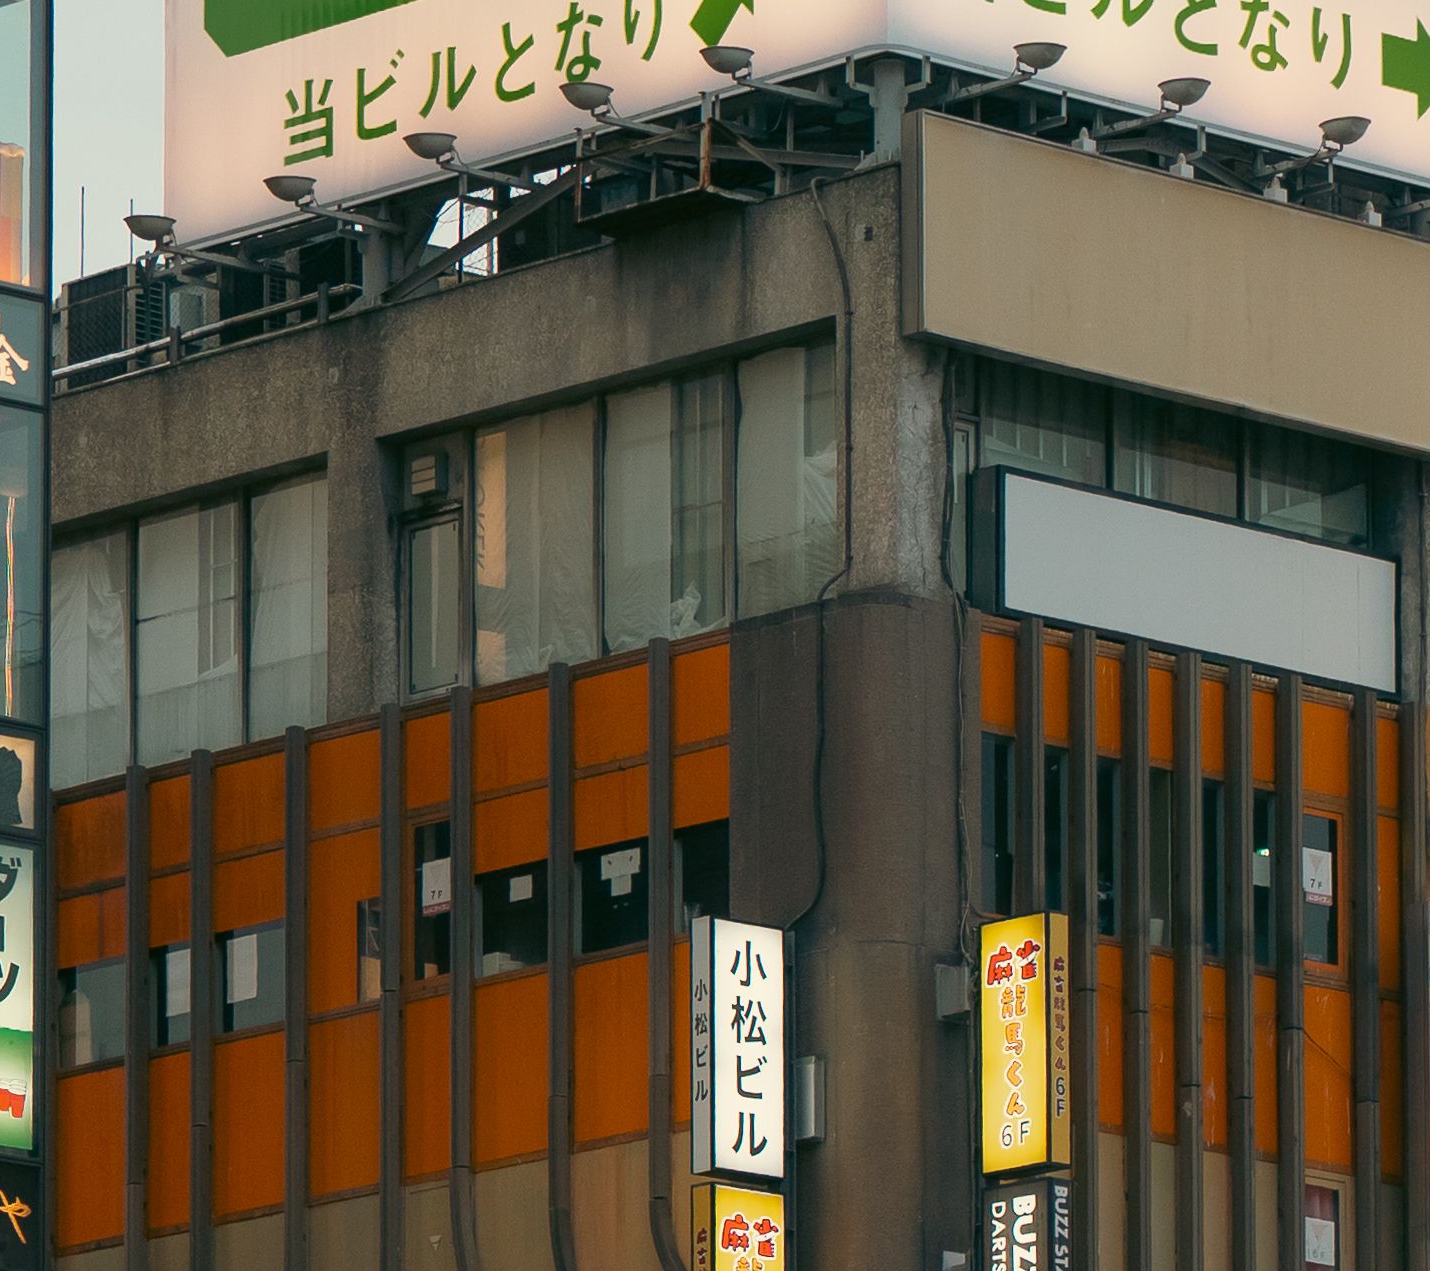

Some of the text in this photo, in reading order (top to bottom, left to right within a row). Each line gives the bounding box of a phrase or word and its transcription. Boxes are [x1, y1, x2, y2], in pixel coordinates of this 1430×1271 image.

[282, 0, 666, 166] 当ビルとなり
[694, 978, 709, 1103] 小松ビル
[730, 940, 768, 1158] 小松ビル
[1001, 1120, 1031, 1148] 6F
[1054, 1185, 1068, 1241] BUZZ
